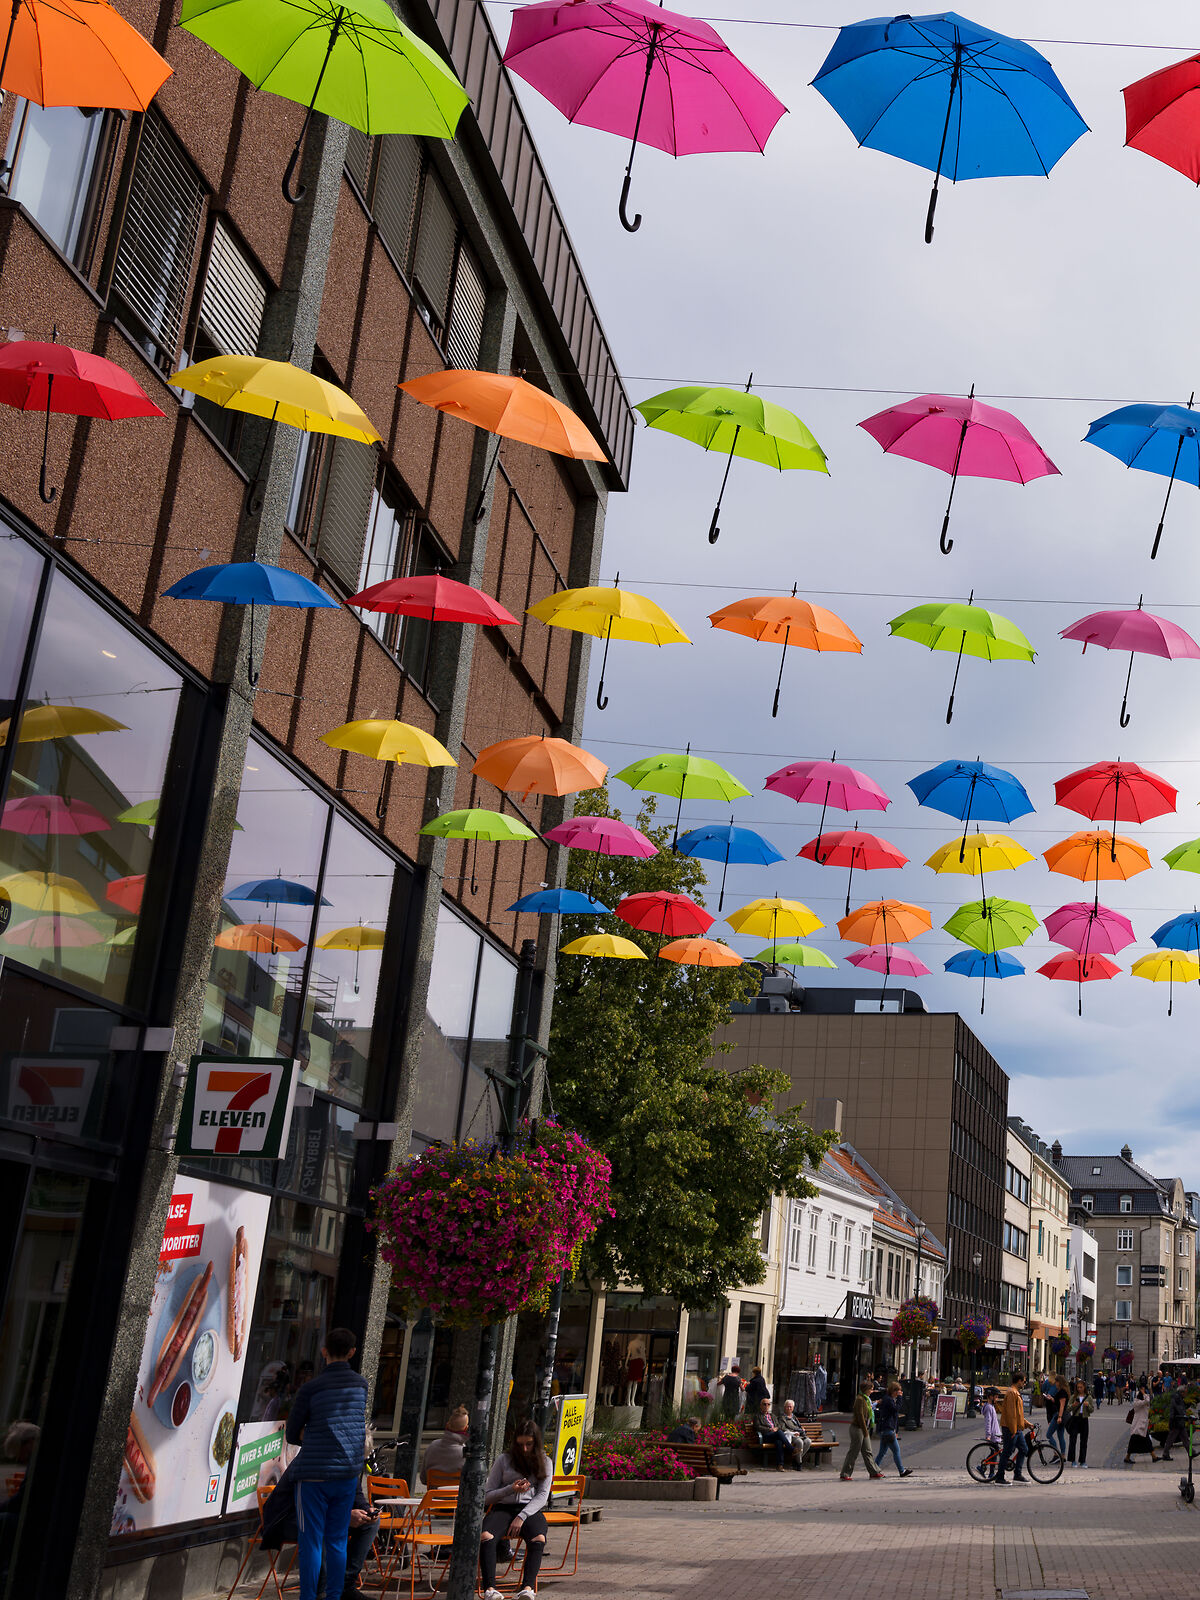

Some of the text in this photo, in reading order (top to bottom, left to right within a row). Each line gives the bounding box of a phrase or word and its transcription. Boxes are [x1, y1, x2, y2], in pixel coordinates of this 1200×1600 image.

[207, 1071, 272, 1154] 7
[167, 1204, 187, 1219] LSE-
[160, 1234, 200, 1252] VORITTER
[564, 1406, 577, 1419] ALLE
[240, 1448, 257, 1466] HVER
[263, 1437, 282, 1455] KAFFE
[236, 1472, 258, 1493] GRATIS
